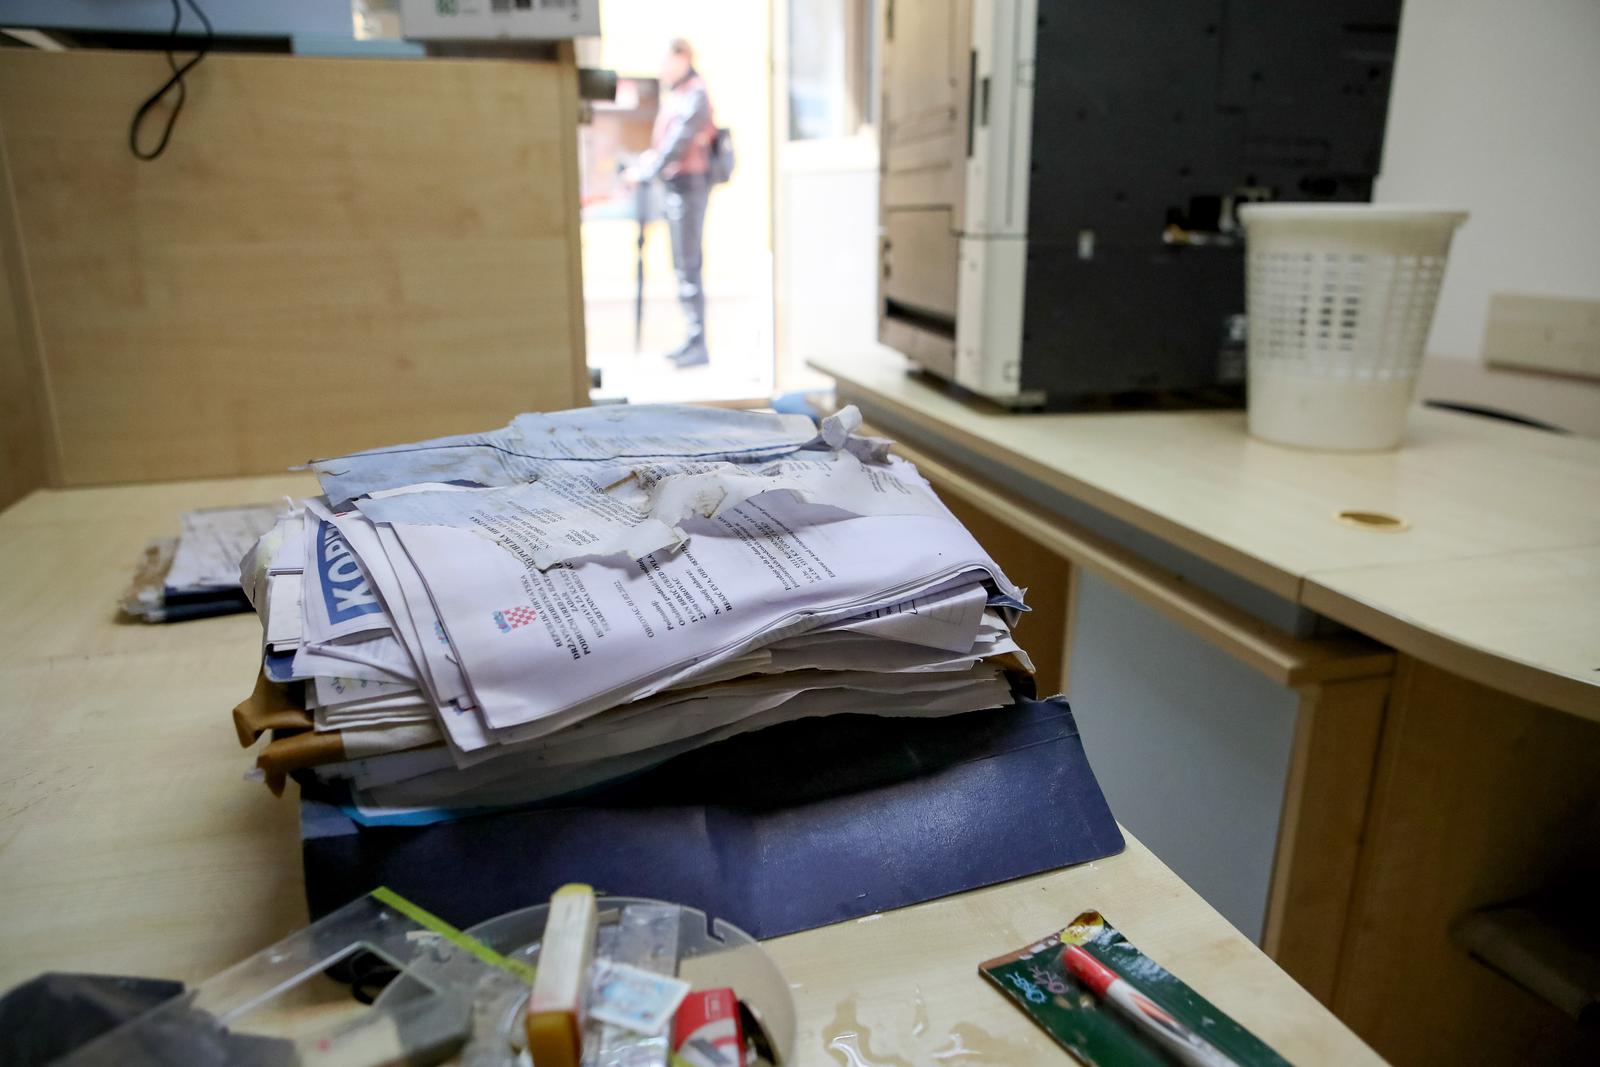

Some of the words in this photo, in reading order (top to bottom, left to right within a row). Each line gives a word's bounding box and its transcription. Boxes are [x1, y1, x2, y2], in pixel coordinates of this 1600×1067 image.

[500, 533, 536, 567] REPUBLIKA
[520, 574, 542, 610] HRVATSKA
[565, 562, 586, 596] OBROVAC
[671, 577, 694, 604] OBROVAC
[538, 586, 562, 624] GEODETSKA
[552, 592, 560, 601] ZA
[557, 600, 571, 619] URED
[562, 592, 578, 612] ZADAR
[574, 594, 583, 604] ZA
[539, 610, 562, 647] REPUBLIKA
[580, 603, 604, 638] ISPOSTAVA
[684, 607, 698, 623] IVAN
[559, 624, 581, 660] DRŽAVNA
